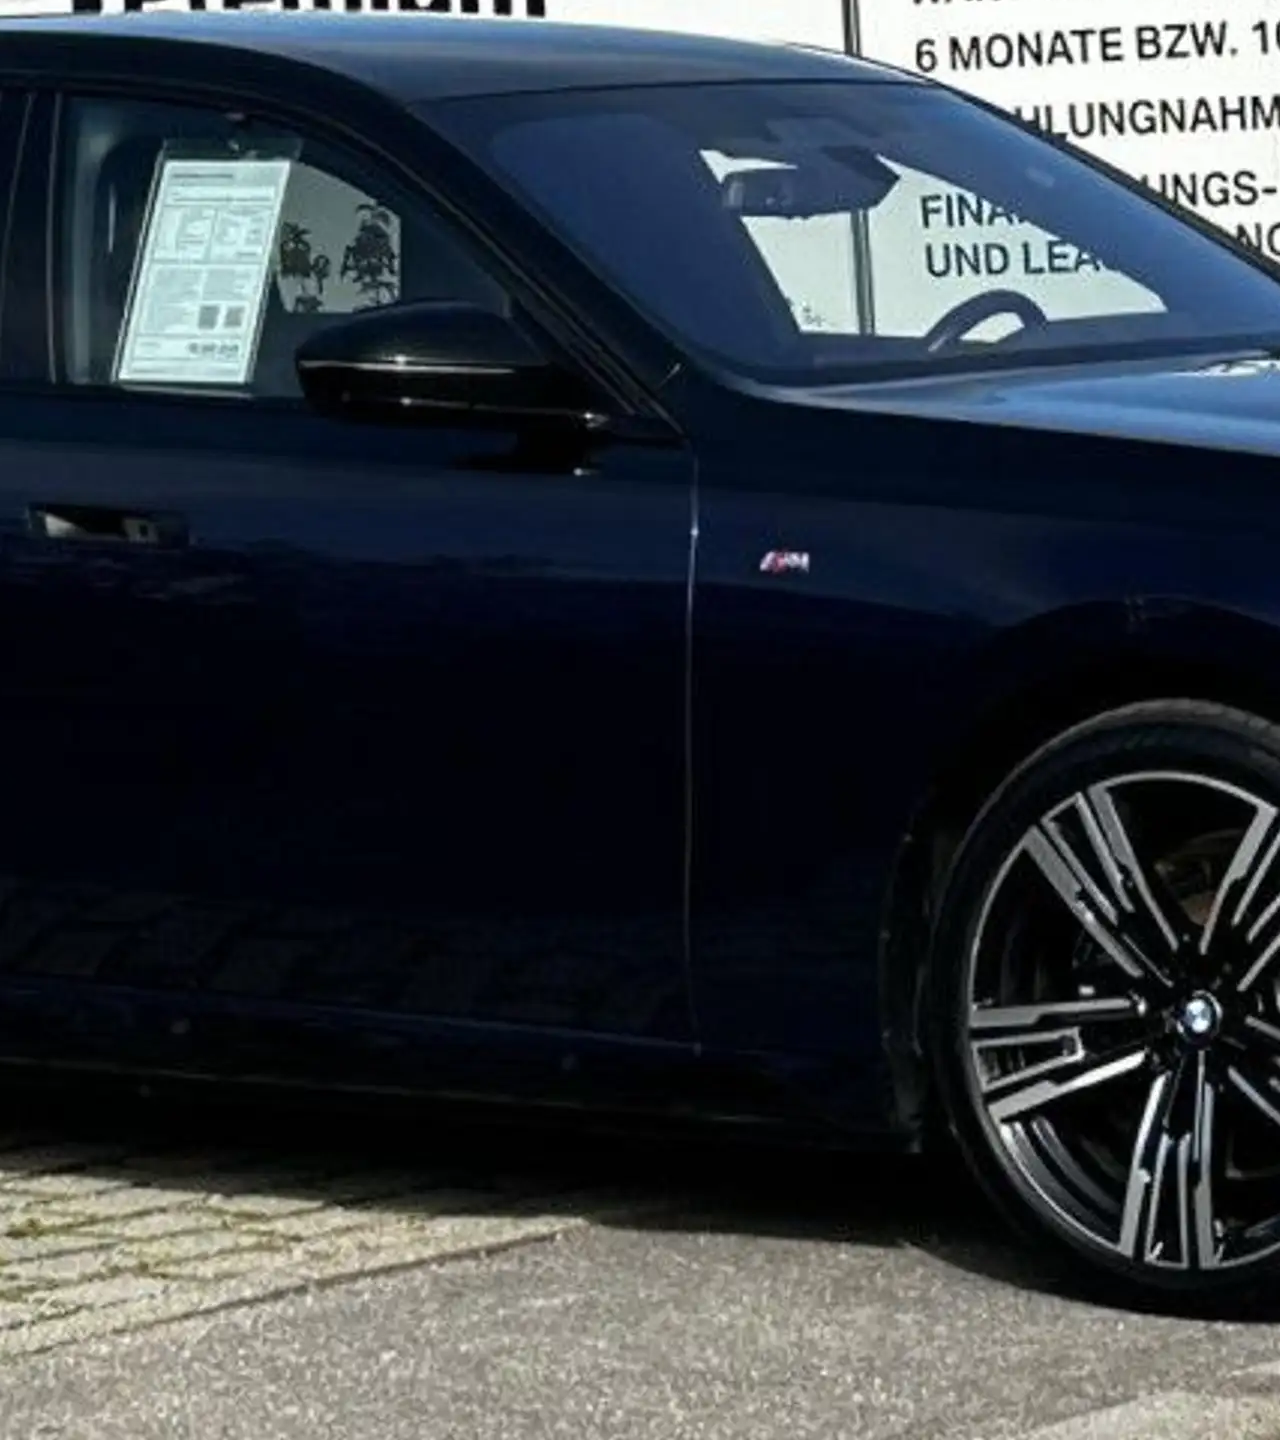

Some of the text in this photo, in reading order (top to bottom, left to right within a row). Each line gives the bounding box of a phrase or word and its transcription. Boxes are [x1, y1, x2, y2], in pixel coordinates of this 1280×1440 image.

[915, 38, 938, 74] 6
[949, 26, 1124, 71] MONATE
[1135, 21, 1239, 60] BZW.
[925, 241, 1010, 278] UND
